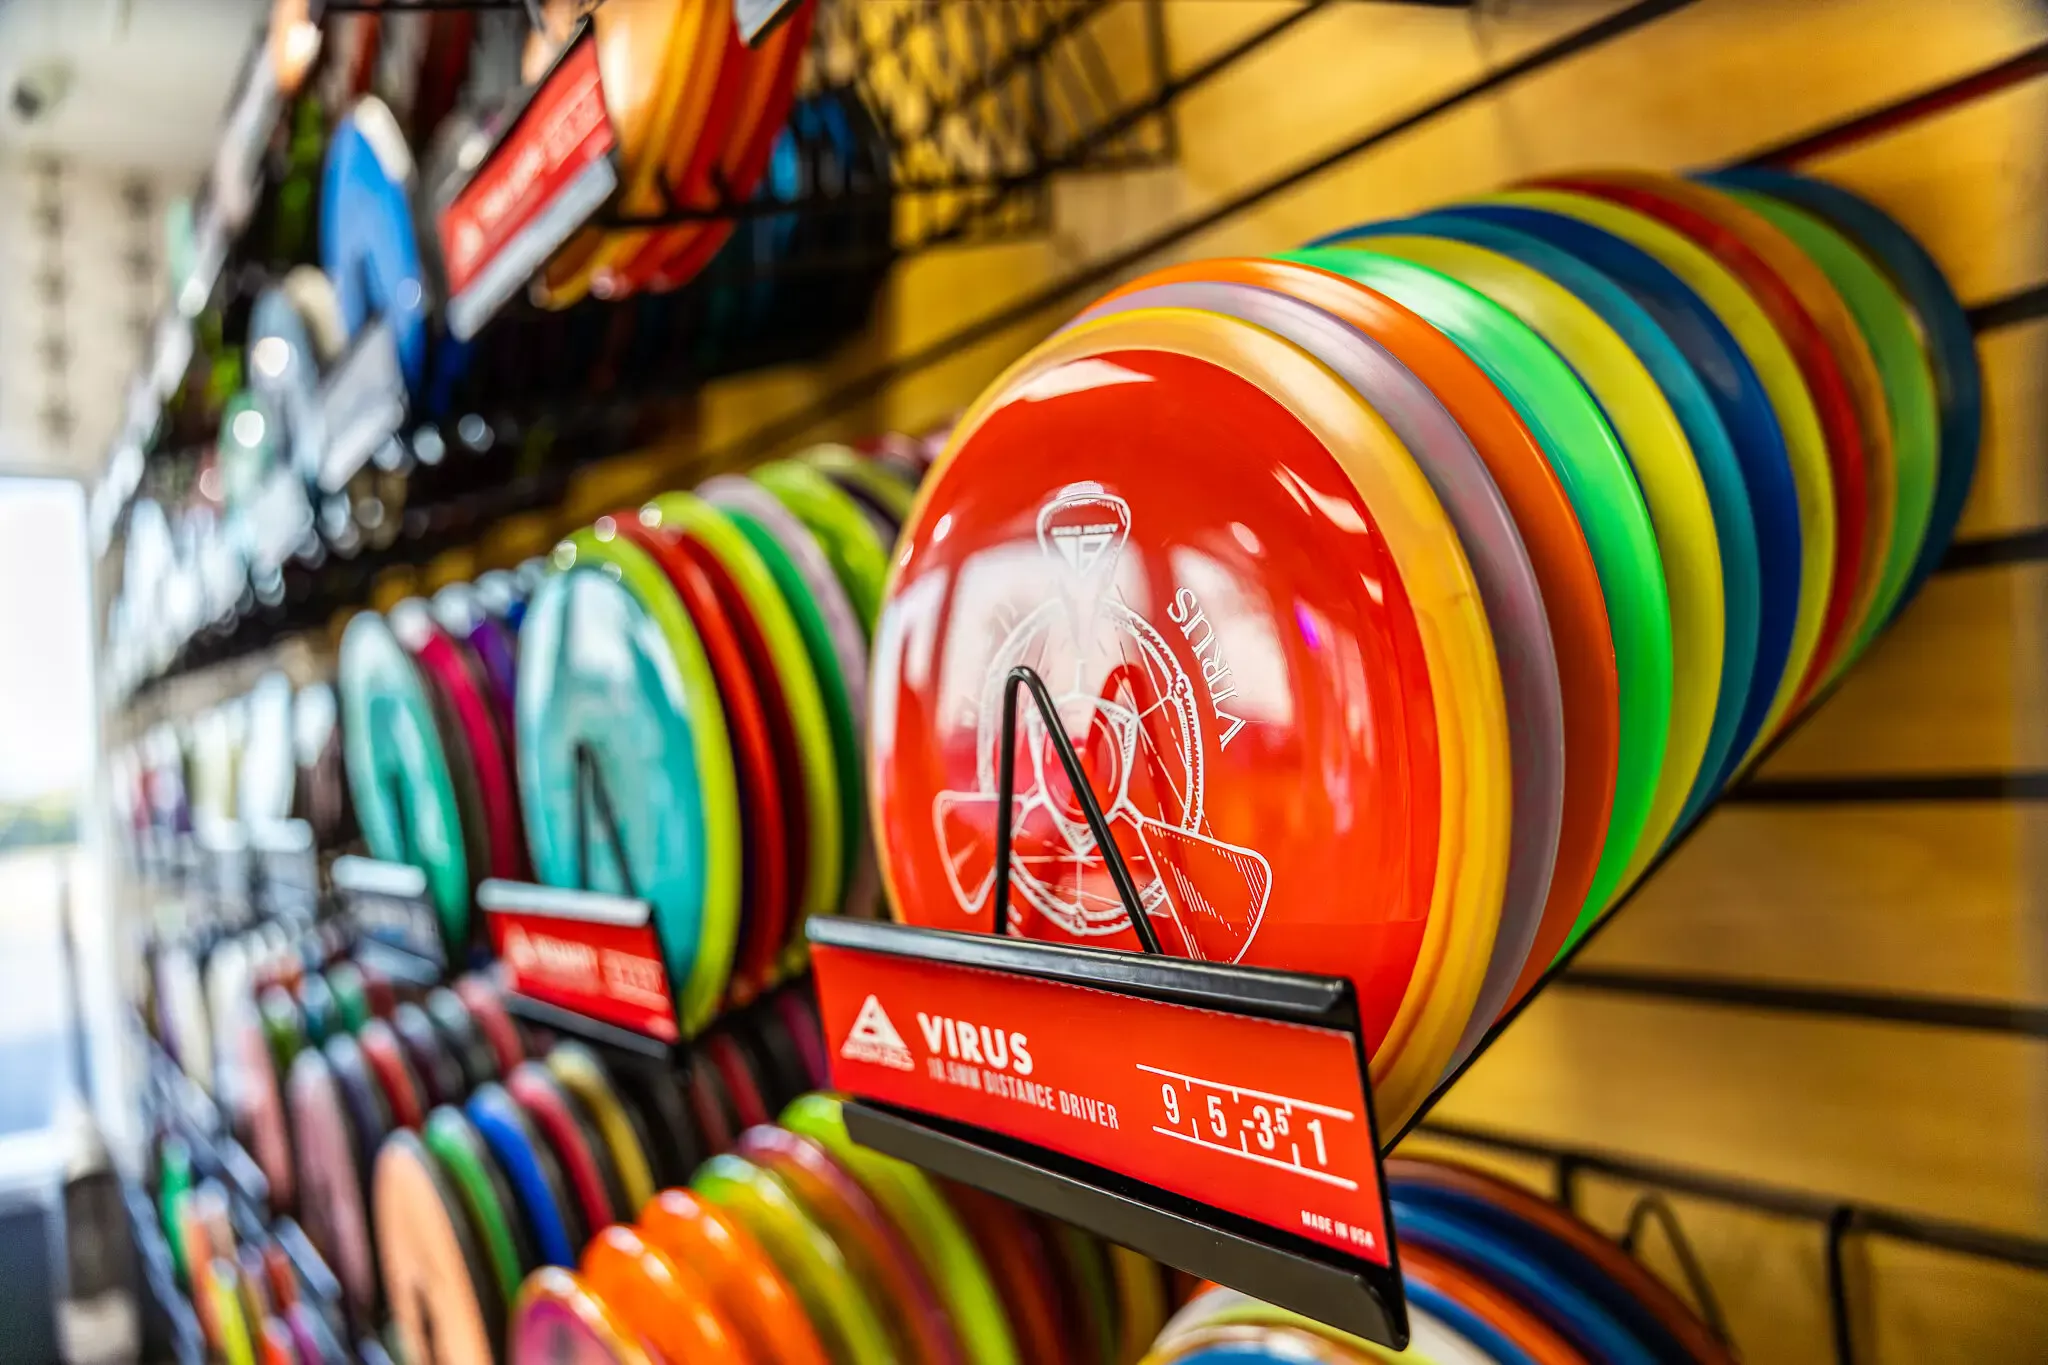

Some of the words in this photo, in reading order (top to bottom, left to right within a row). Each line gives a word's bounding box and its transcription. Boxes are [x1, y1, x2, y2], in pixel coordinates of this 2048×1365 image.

[1166, 587, 1247, 752] VIRUS
[916, 1012, 1033, 1075] VIRUS
[982, 1069, 1056, 1112] DISTANCE
[1059, 1090, 1120, 1130] DRIVER
[1161, 1083, 1181, 1125] 9
[1206, 1094, 1228, 1138] 5
[1307, 1118, 1328, 1166] 1
[1301, 1210, 1333, 1235] MADE
[1334, 1220, 1349, 1240] IN
[1349, 1225, 1376, 1249] USA
